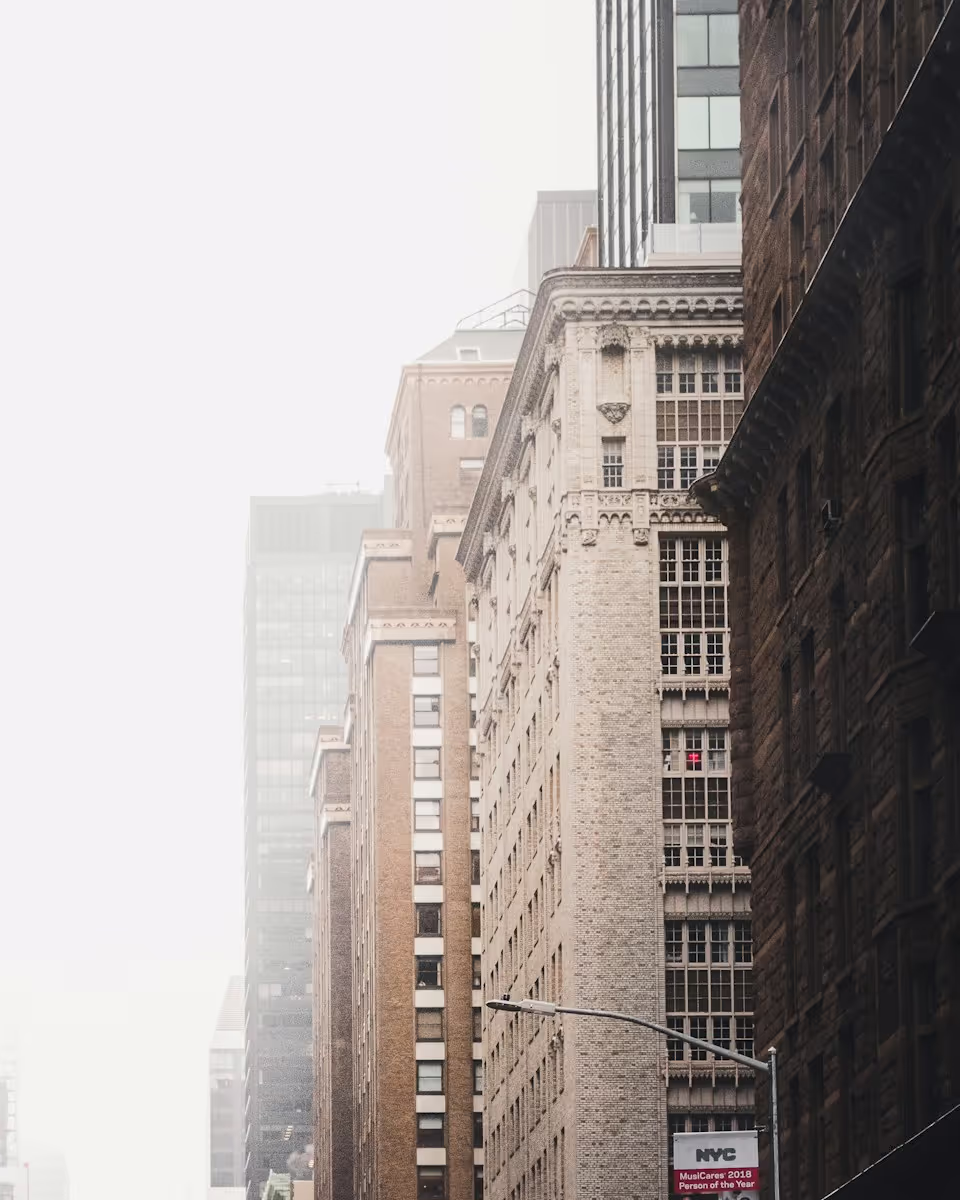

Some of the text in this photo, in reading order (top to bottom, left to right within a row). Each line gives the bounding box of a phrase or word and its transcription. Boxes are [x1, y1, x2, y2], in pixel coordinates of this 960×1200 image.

[696, 1148, 736, 1162] NYC
[727, 1170, 752, 1179] 2018
[679, 1180, 755, 1190] Person of the Year
